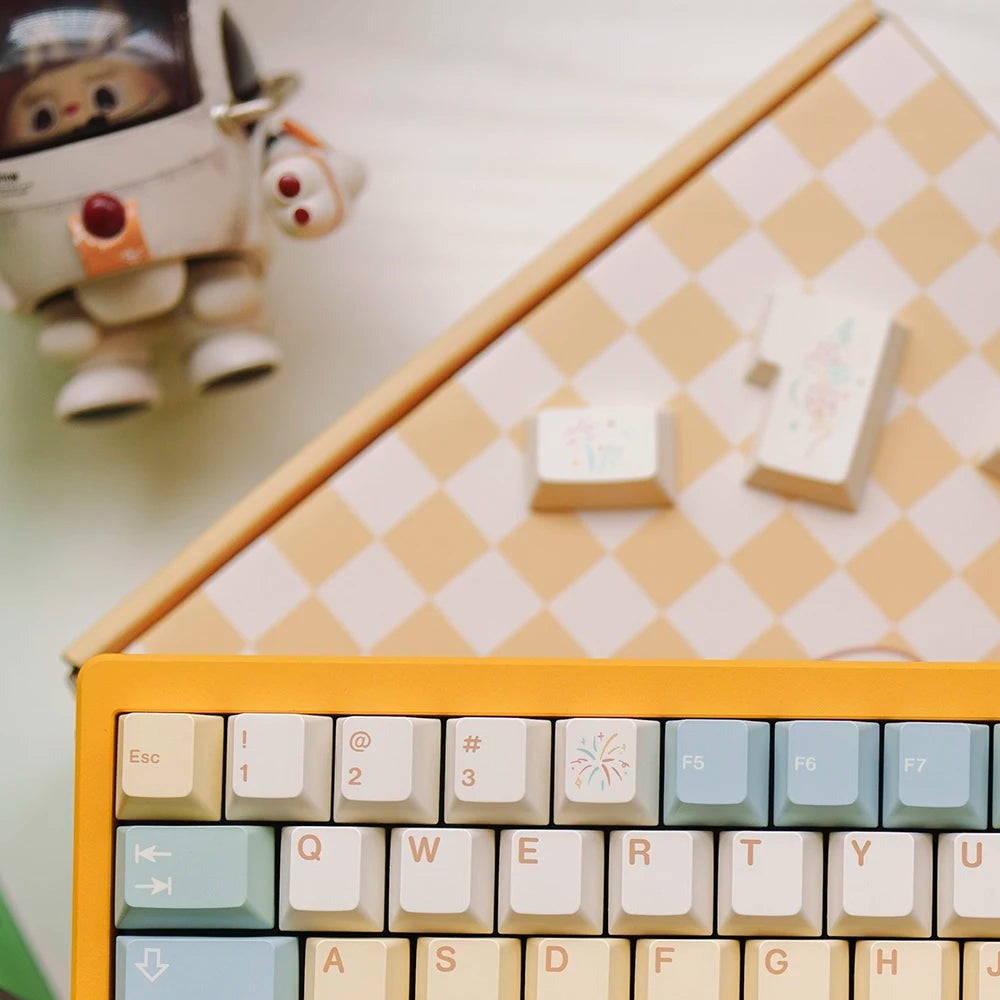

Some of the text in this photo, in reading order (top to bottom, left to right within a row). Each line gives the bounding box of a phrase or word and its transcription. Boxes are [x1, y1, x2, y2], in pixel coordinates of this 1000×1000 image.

[241, 730, 248, 748] !
[349, 731, 371, 752] @
[462, 736, 482, 753] #
[130, 749, 160, 764] Esc
[682, 755, 705, 770] F5
[794, 757, 816, 771] F6
[904, 758, 927, 773] F7
[240, 765, 248, 782] 1
[348, 767, 362, 786] 2
[462, 769, 476, 787] 3
[298, 834, 322, 861] Q
[409, 836, 441, 863] W
[518, 837, 538, 864] E
[629, 839, 651, 866] R
[740, 839, 761, 866] T
[851, 840, 871, 866] Y
[962, 841, 983, 868] U
[323, 947, 345, 973] A
[436, 947, 457, 973] S
[545, 946, 568, 973] D
[655, 947, 675, 973] F
[764, 948, 788, 975] G
[876, 948, 898, 975] H
